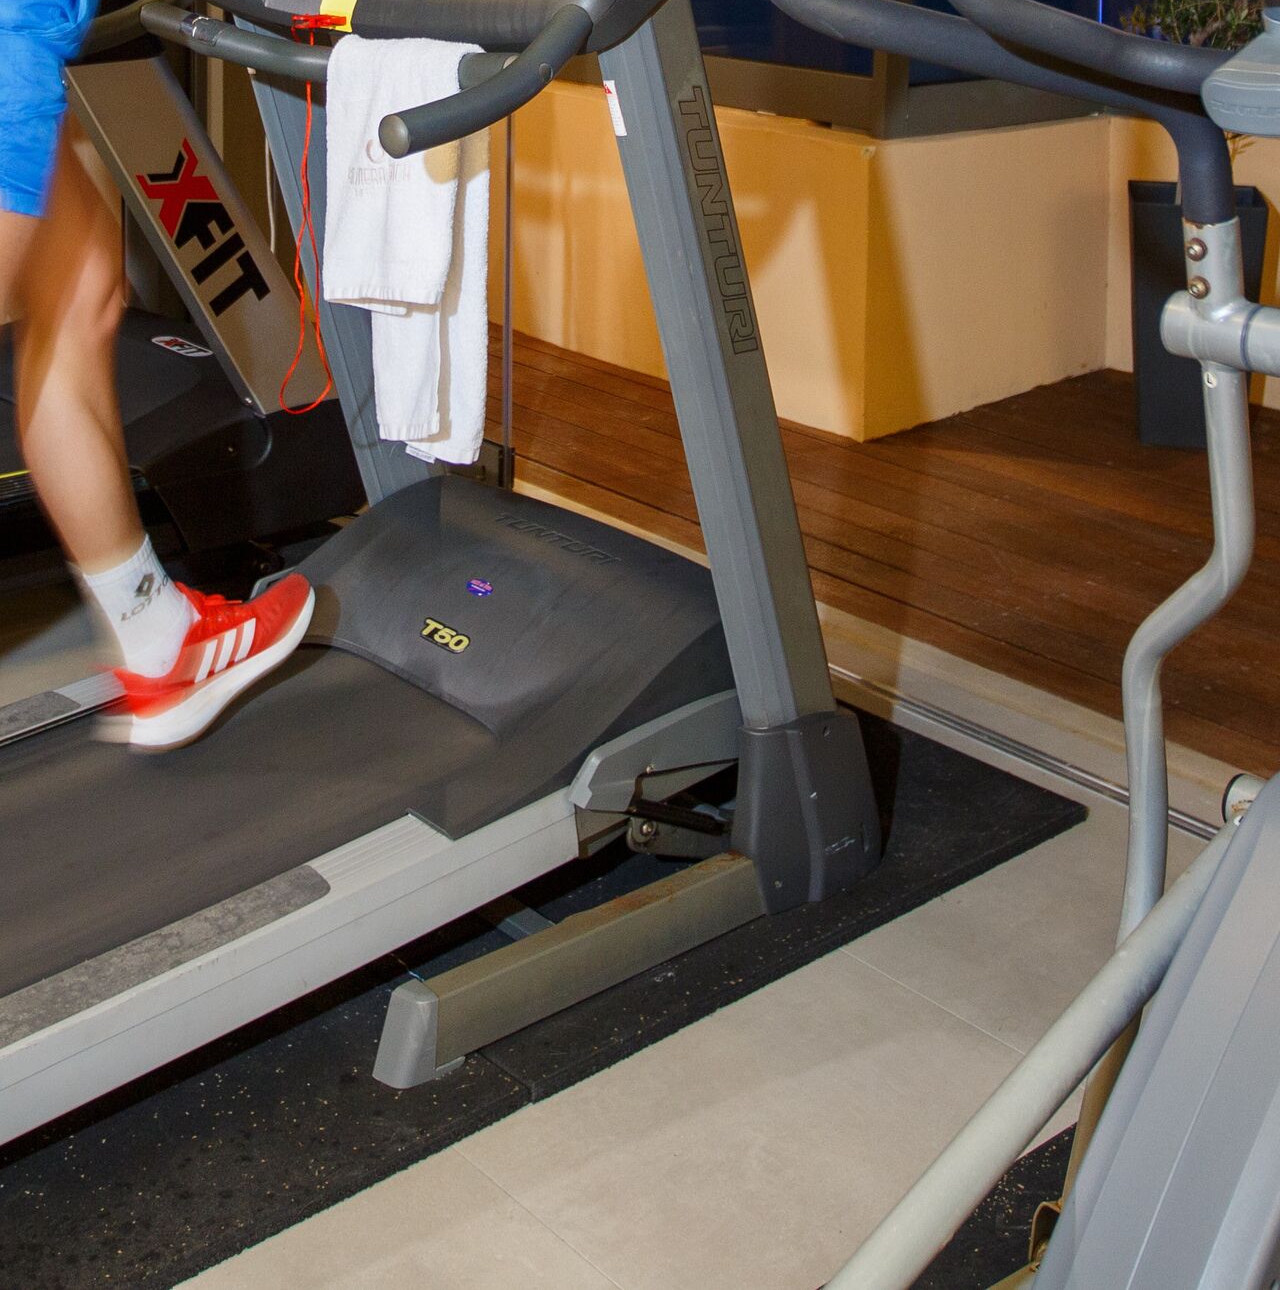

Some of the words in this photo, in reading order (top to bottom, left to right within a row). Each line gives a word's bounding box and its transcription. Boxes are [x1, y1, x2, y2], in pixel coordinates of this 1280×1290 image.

[135, 137, 270, 318] XFIT
[678, 86, 758, 355] TUNTURI
[120, 575, 169, 622] LOTTO
[421, 618, 470, 653] T50
